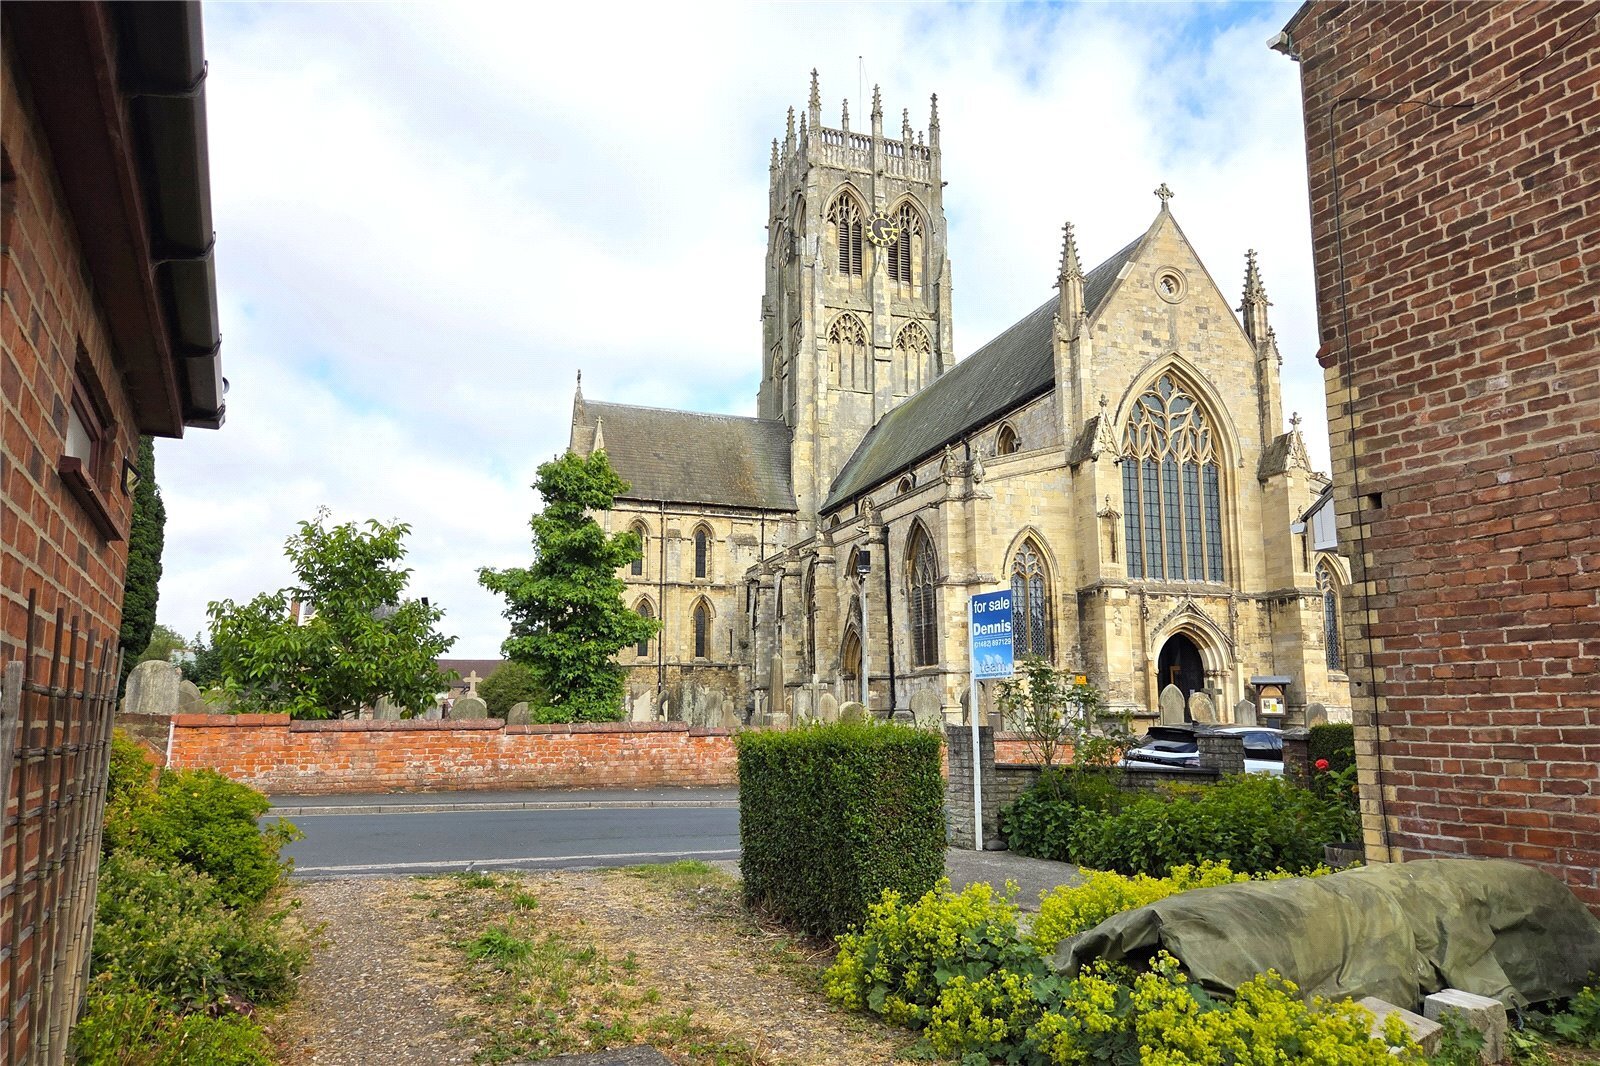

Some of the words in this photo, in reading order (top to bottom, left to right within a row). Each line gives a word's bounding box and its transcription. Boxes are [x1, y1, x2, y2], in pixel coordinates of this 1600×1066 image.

[974, 601, 986, 613] for
[989, 597, 1010, 611] sale
[973, 620, 1011, 636] Dennis
